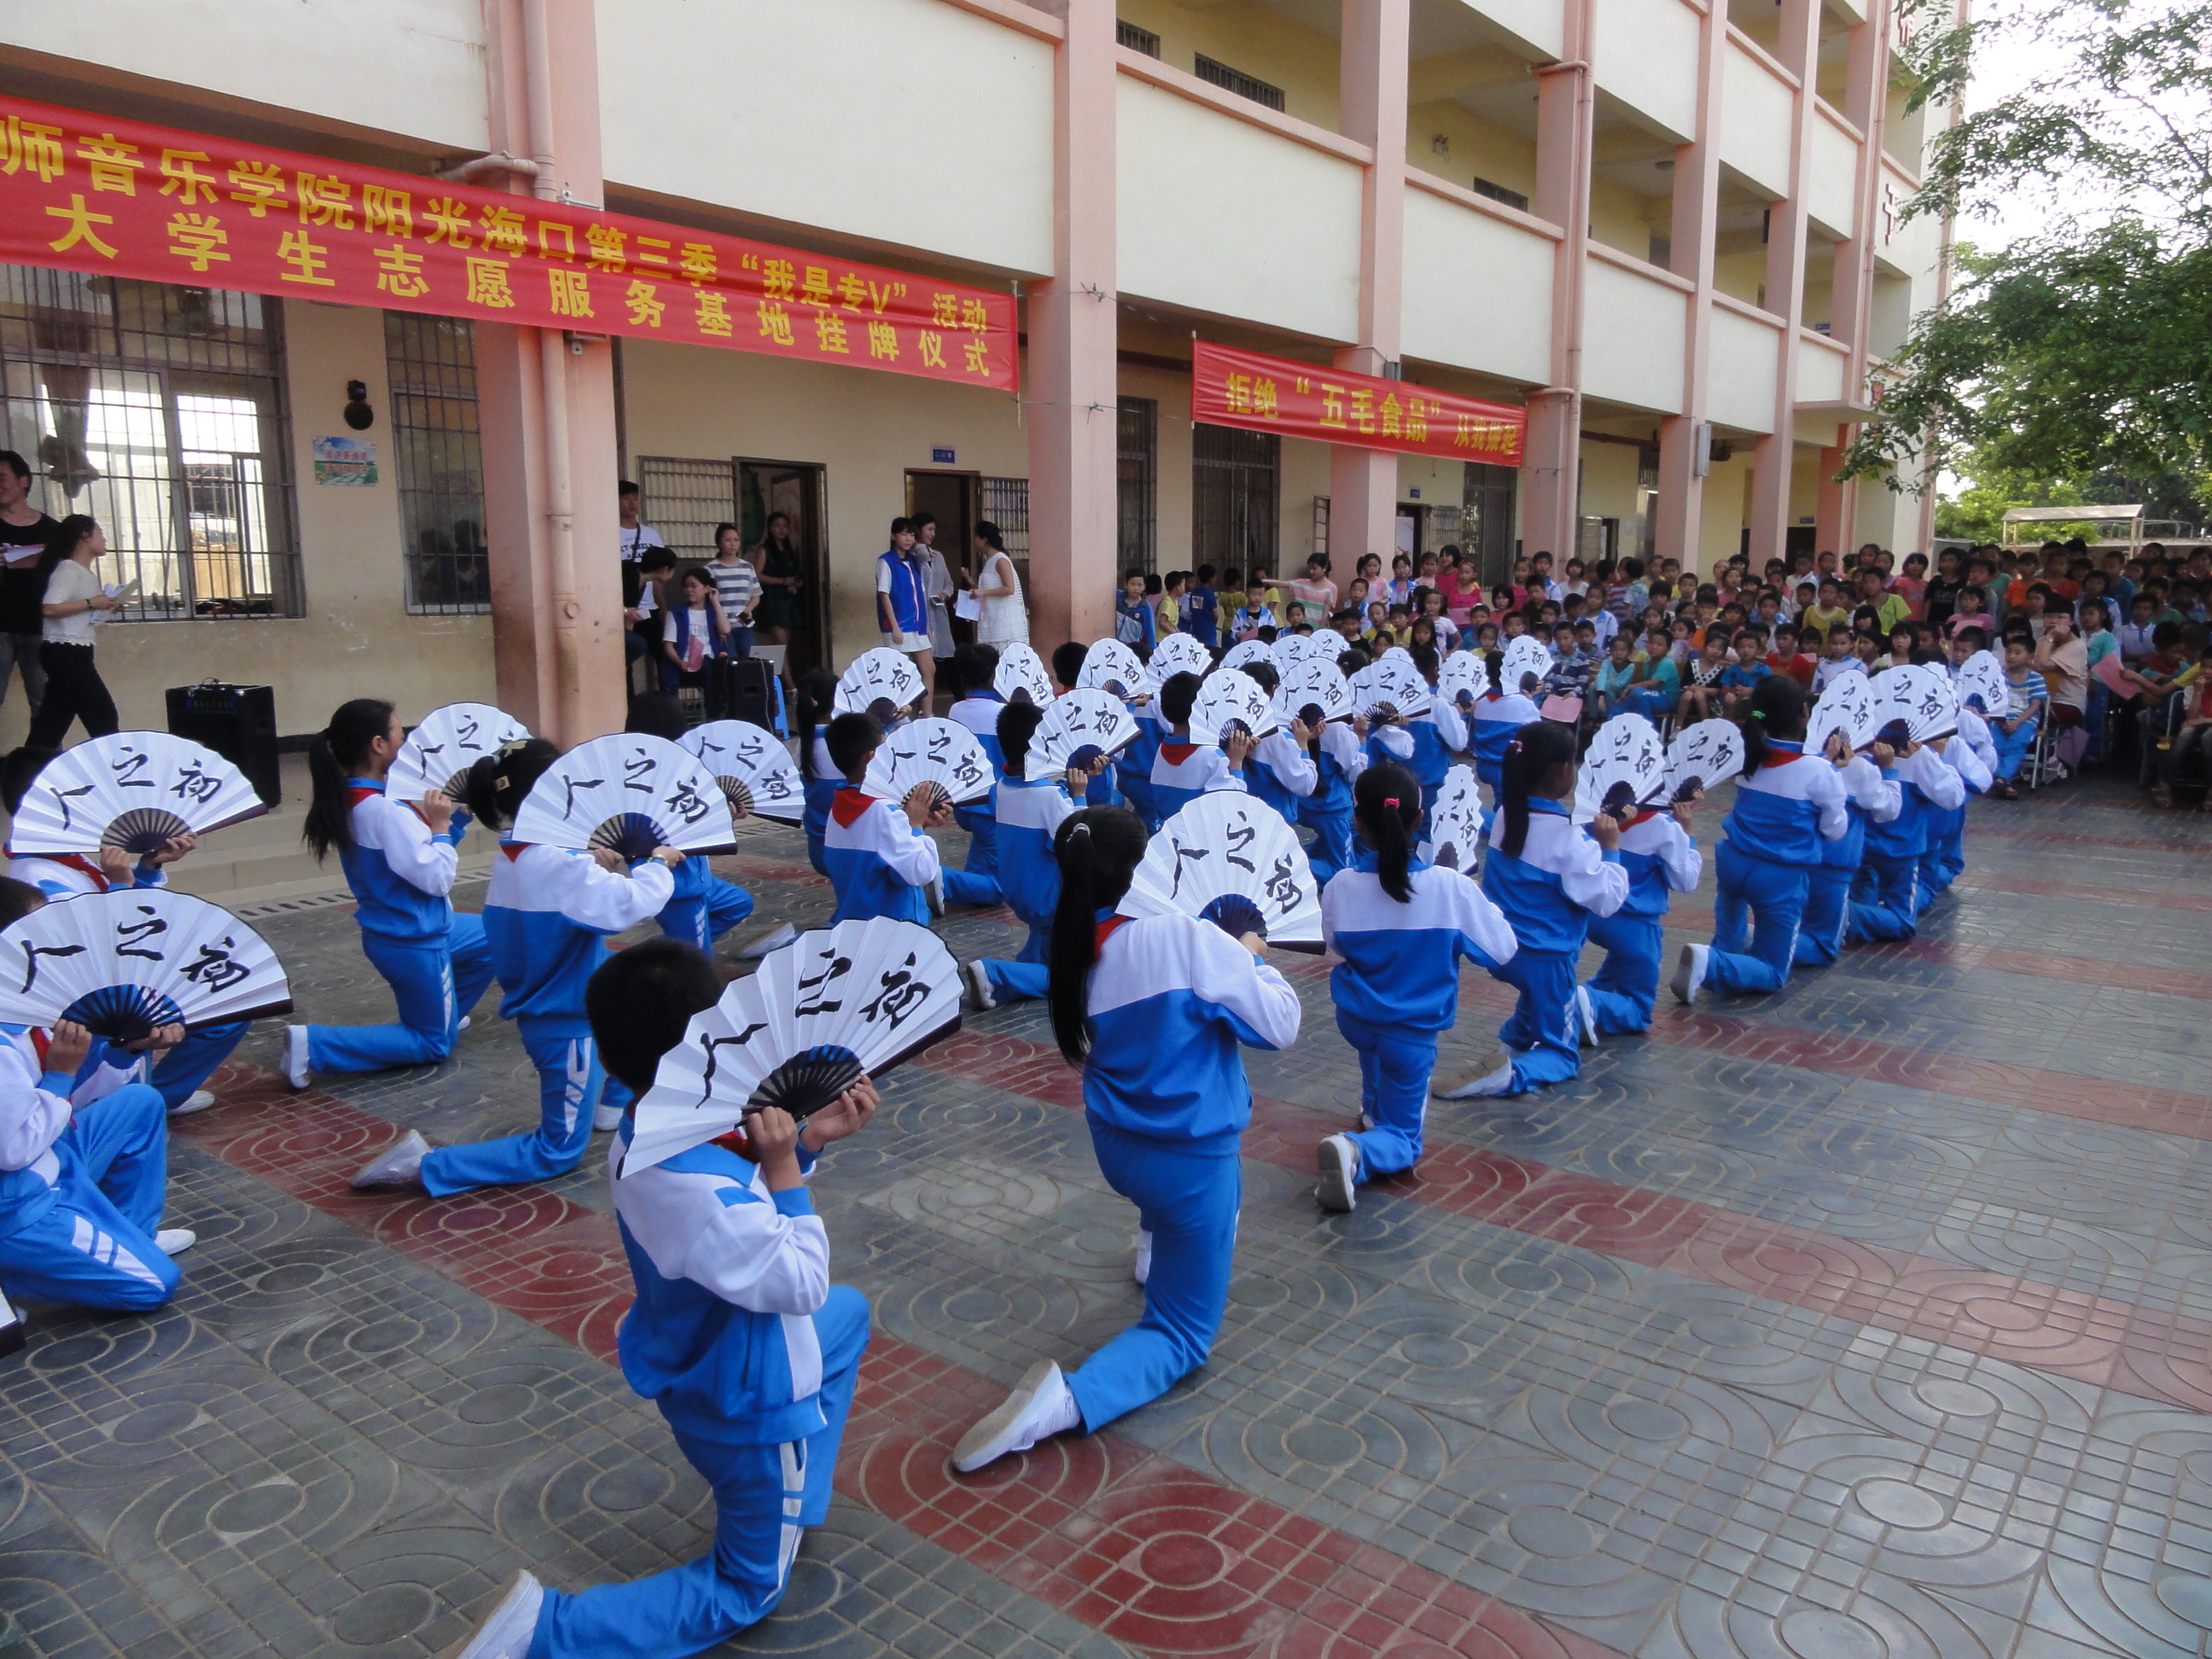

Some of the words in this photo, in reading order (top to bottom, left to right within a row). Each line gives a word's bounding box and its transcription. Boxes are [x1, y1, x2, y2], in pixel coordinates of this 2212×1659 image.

[45, 194, 989, 377] 大学生志愿服务基地挂牌仪式
[843, 658, 911, 713] 人之初
[1004, 651, 1048, 701] 人之初
[1089, 646, 1140, 687] 人之初
[1282, 667, 1342, 714] 人之初
[1352, 667, 1421, 705] 人之初
[1042, 701, 1119, 764] 人之初
[1202, 677, 1264, 728] 人之初
[49, 746, 222, 831] 人之初
[562, 748, 710, 824] 人之初
[888, 727, 983, 788] 人之初
[1589, 725, 1656, 799] 人之初
[1169, 811, 1302, 914] 人之初
[20, 905, 251, 994] 人之初
[696, 947, 932, 1109] 人之初
